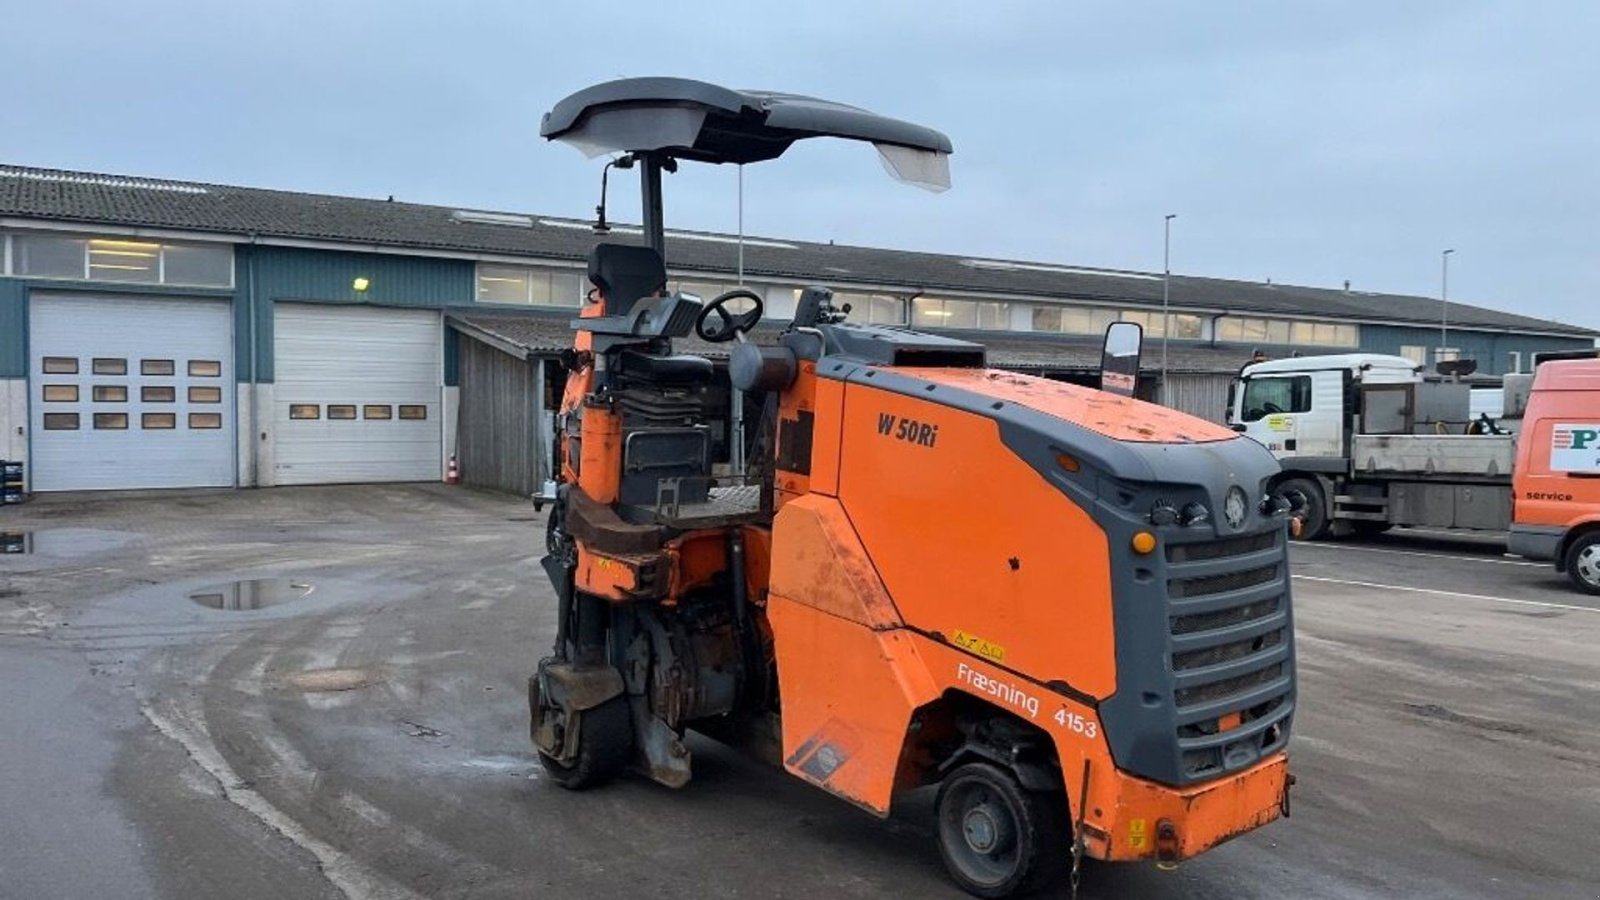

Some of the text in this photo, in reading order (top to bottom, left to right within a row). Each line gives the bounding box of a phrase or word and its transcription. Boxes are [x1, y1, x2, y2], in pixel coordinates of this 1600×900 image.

[878, 412, 938, 448] W 50Ri
[1570, 429, 1600, 450] P
[1526, 491, 1573, 501] service
[957, 662, 1039, 718] Fræsning
[1054, 709, 1097, 739] 4153
